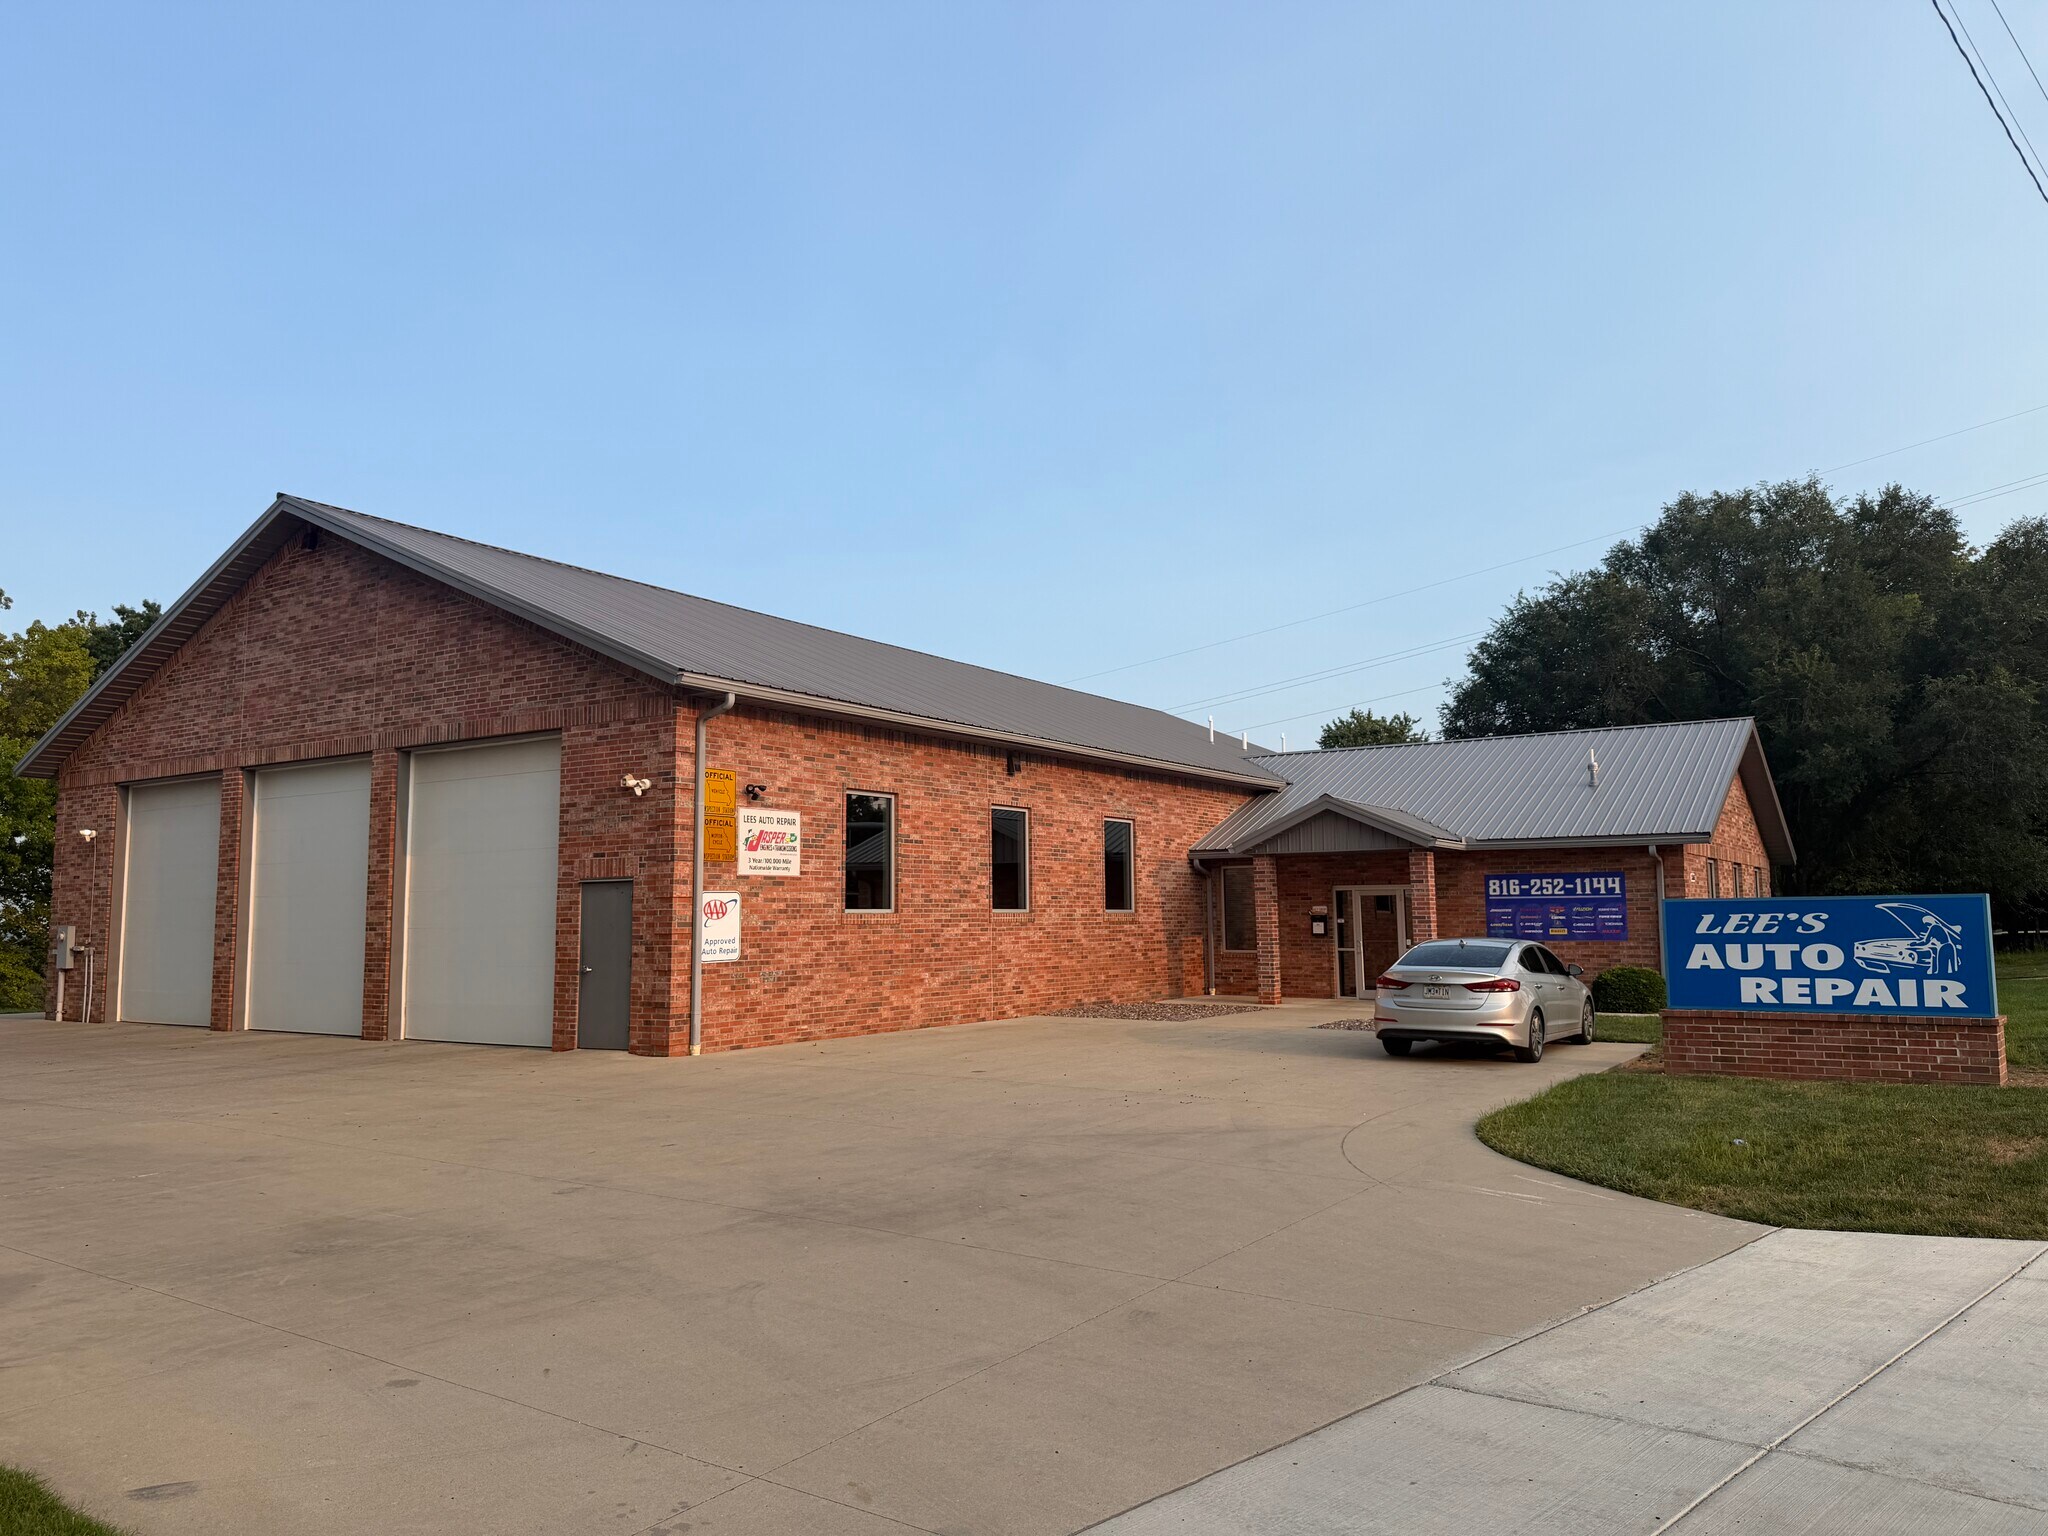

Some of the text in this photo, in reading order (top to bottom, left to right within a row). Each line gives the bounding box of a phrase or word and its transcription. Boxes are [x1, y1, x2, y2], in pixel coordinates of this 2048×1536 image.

[705, 771, 733, 781] OFFICIAL
[704, 818, 733, 828] OFFICIAL
[743, 815, 797, 826] LEES AUTO REPAIR
[747, 829, 787, 851] JASPER
[772, 865, 791, 873] Warranty
[1488, 877, 1622, 896] 816-252-1144
[1695, 912, 1829, 934] LEE'S
[704, 937, 736, 946] Approved
[718, 947, 738, 955] Repair
[1685, 943, 1845, 971] AUTO
[1740, 977, 1969, 1008] REPAIR
